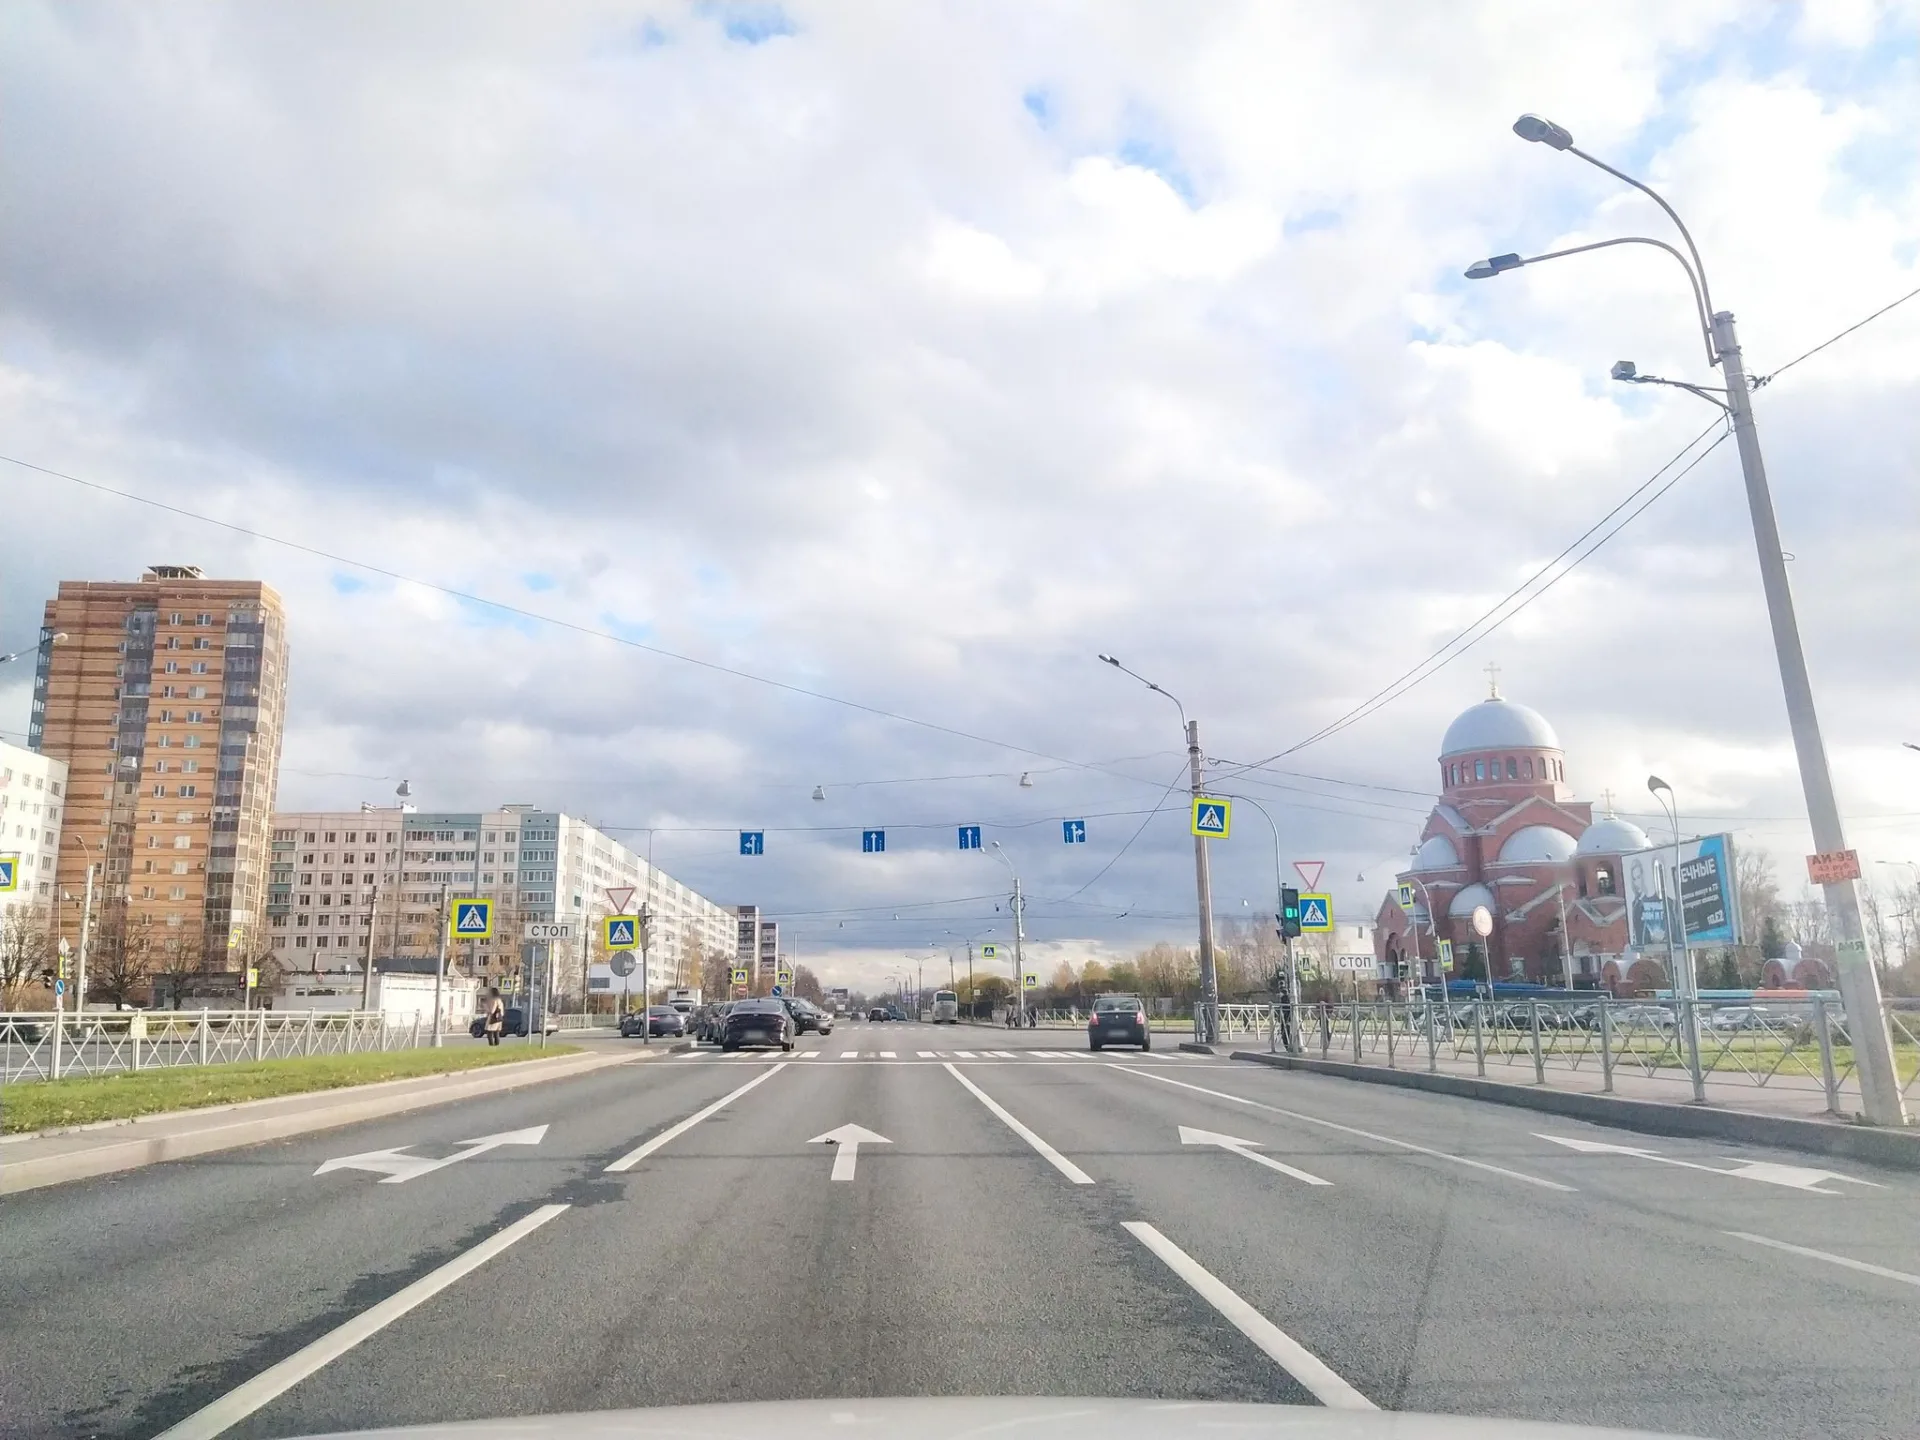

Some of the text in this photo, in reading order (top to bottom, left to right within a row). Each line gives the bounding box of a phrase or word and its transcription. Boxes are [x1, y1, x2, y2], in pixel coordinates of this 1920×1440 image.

[1679, 858, 1716, 883] ЕЧНЫЕ
[531, 925, 569, 937] СТОП
[1339, 956, 1371, 968] СТОП
